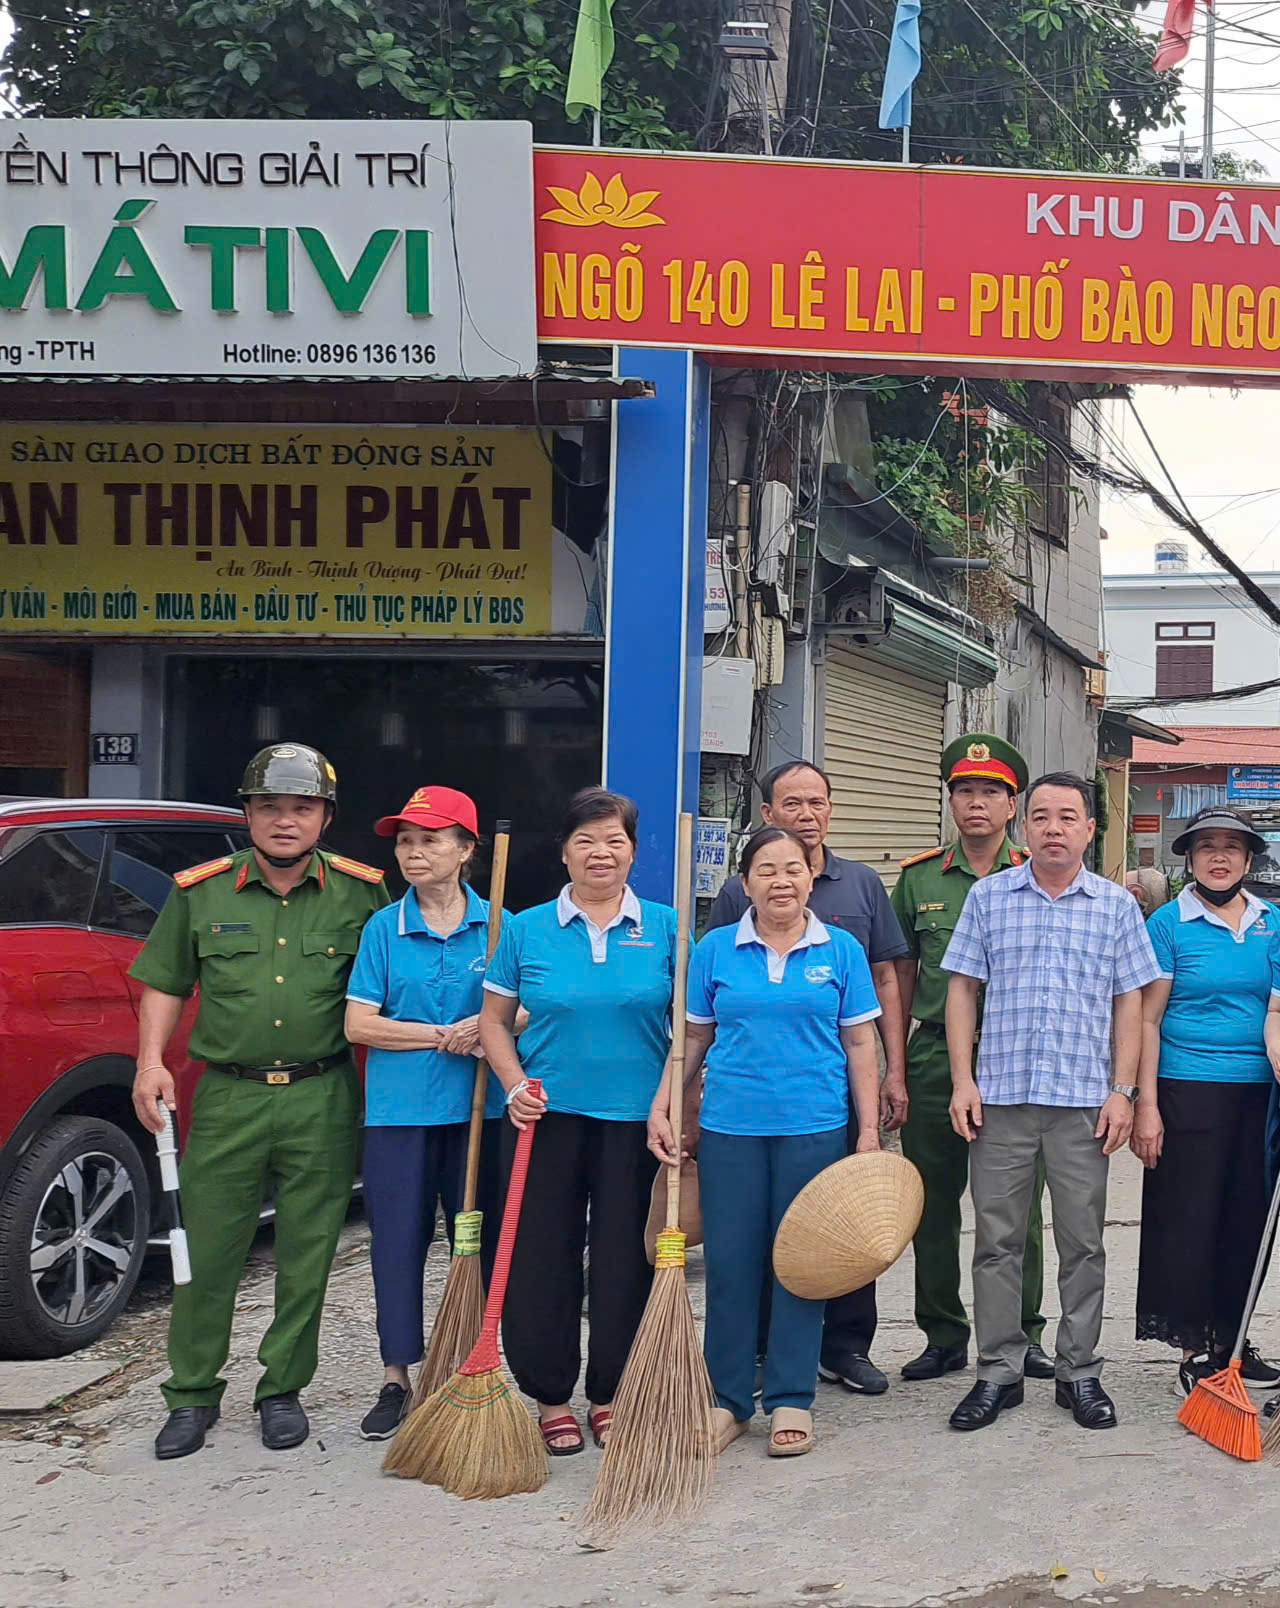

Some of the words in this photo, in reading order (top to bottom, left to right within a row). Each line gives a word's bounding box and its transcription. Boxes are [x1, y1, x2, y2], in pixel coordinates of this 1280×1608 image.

[0, 132, 68, 185] ỀN
[82, 143, 244, 187] THÔNG
[259, 141, 340, 187] GIẢI
[355, 143, 431, 187] TRÍ
[1026, 192, 1143, 240] KHU
[0, 199, 183, 313] MÁ
[184, 225, 434, 317] TIVI
[543, 243, 644, 322] NGÕ
[662, 259, 749, 327] 140
[770, 250, 826, 331] LÊ
[845, 265, 924, 335] LAI
[937, 296, 956, 312] -
[968, 259, 1064, 341] PHỐ
[1081, 266, 1173, 347] BÀO
[223, 343, 302, 364] Hotline:
[306, 345, 358, 364] 0896
[362, 345, 397, 364] 136
[401, 345, 436, 364] 136
[11, 435, 75, 462] SÀN
[85, 442, 164, 463] GIAO
[174, 443, 252, 470] DỊCH
[261, 434, 322, 465] BẤT
[331, 438, 421, 471] ĐỘNG
[431, 436, 495, 467] SẢN
[103, 483, 317, 561] THỊNH
[346, 472, 531, 550] PHÁT
[216, 560, 245, 578] An
[251, 559, 293, 578] Bình
[307, 560, 358, 582] Thịnh
[364, 561, 421, 583] Vượng
[436, 561, 482, 581] Phát
[486, 562, 529, 584] Đạt!
[63, 586, 97, 619] MÔI
[103, 584, 138, 619] GIỚI
[155, 592, 195, 620] MUA
[201, 588, 237, 620] BÁN
[254, 584, 290, 621] ĐẦU
[296, 591, 319, 621] TƯ
[334, 583, 367, 622] THỦ
[373, 594, 405, 628] TỤC
[411, 589, 458, 623] PHÁP
[463, 590, 484, 623] LÝ
[489, 596, 525, 624] BĐS
[97, 736, 132, 755] 138
